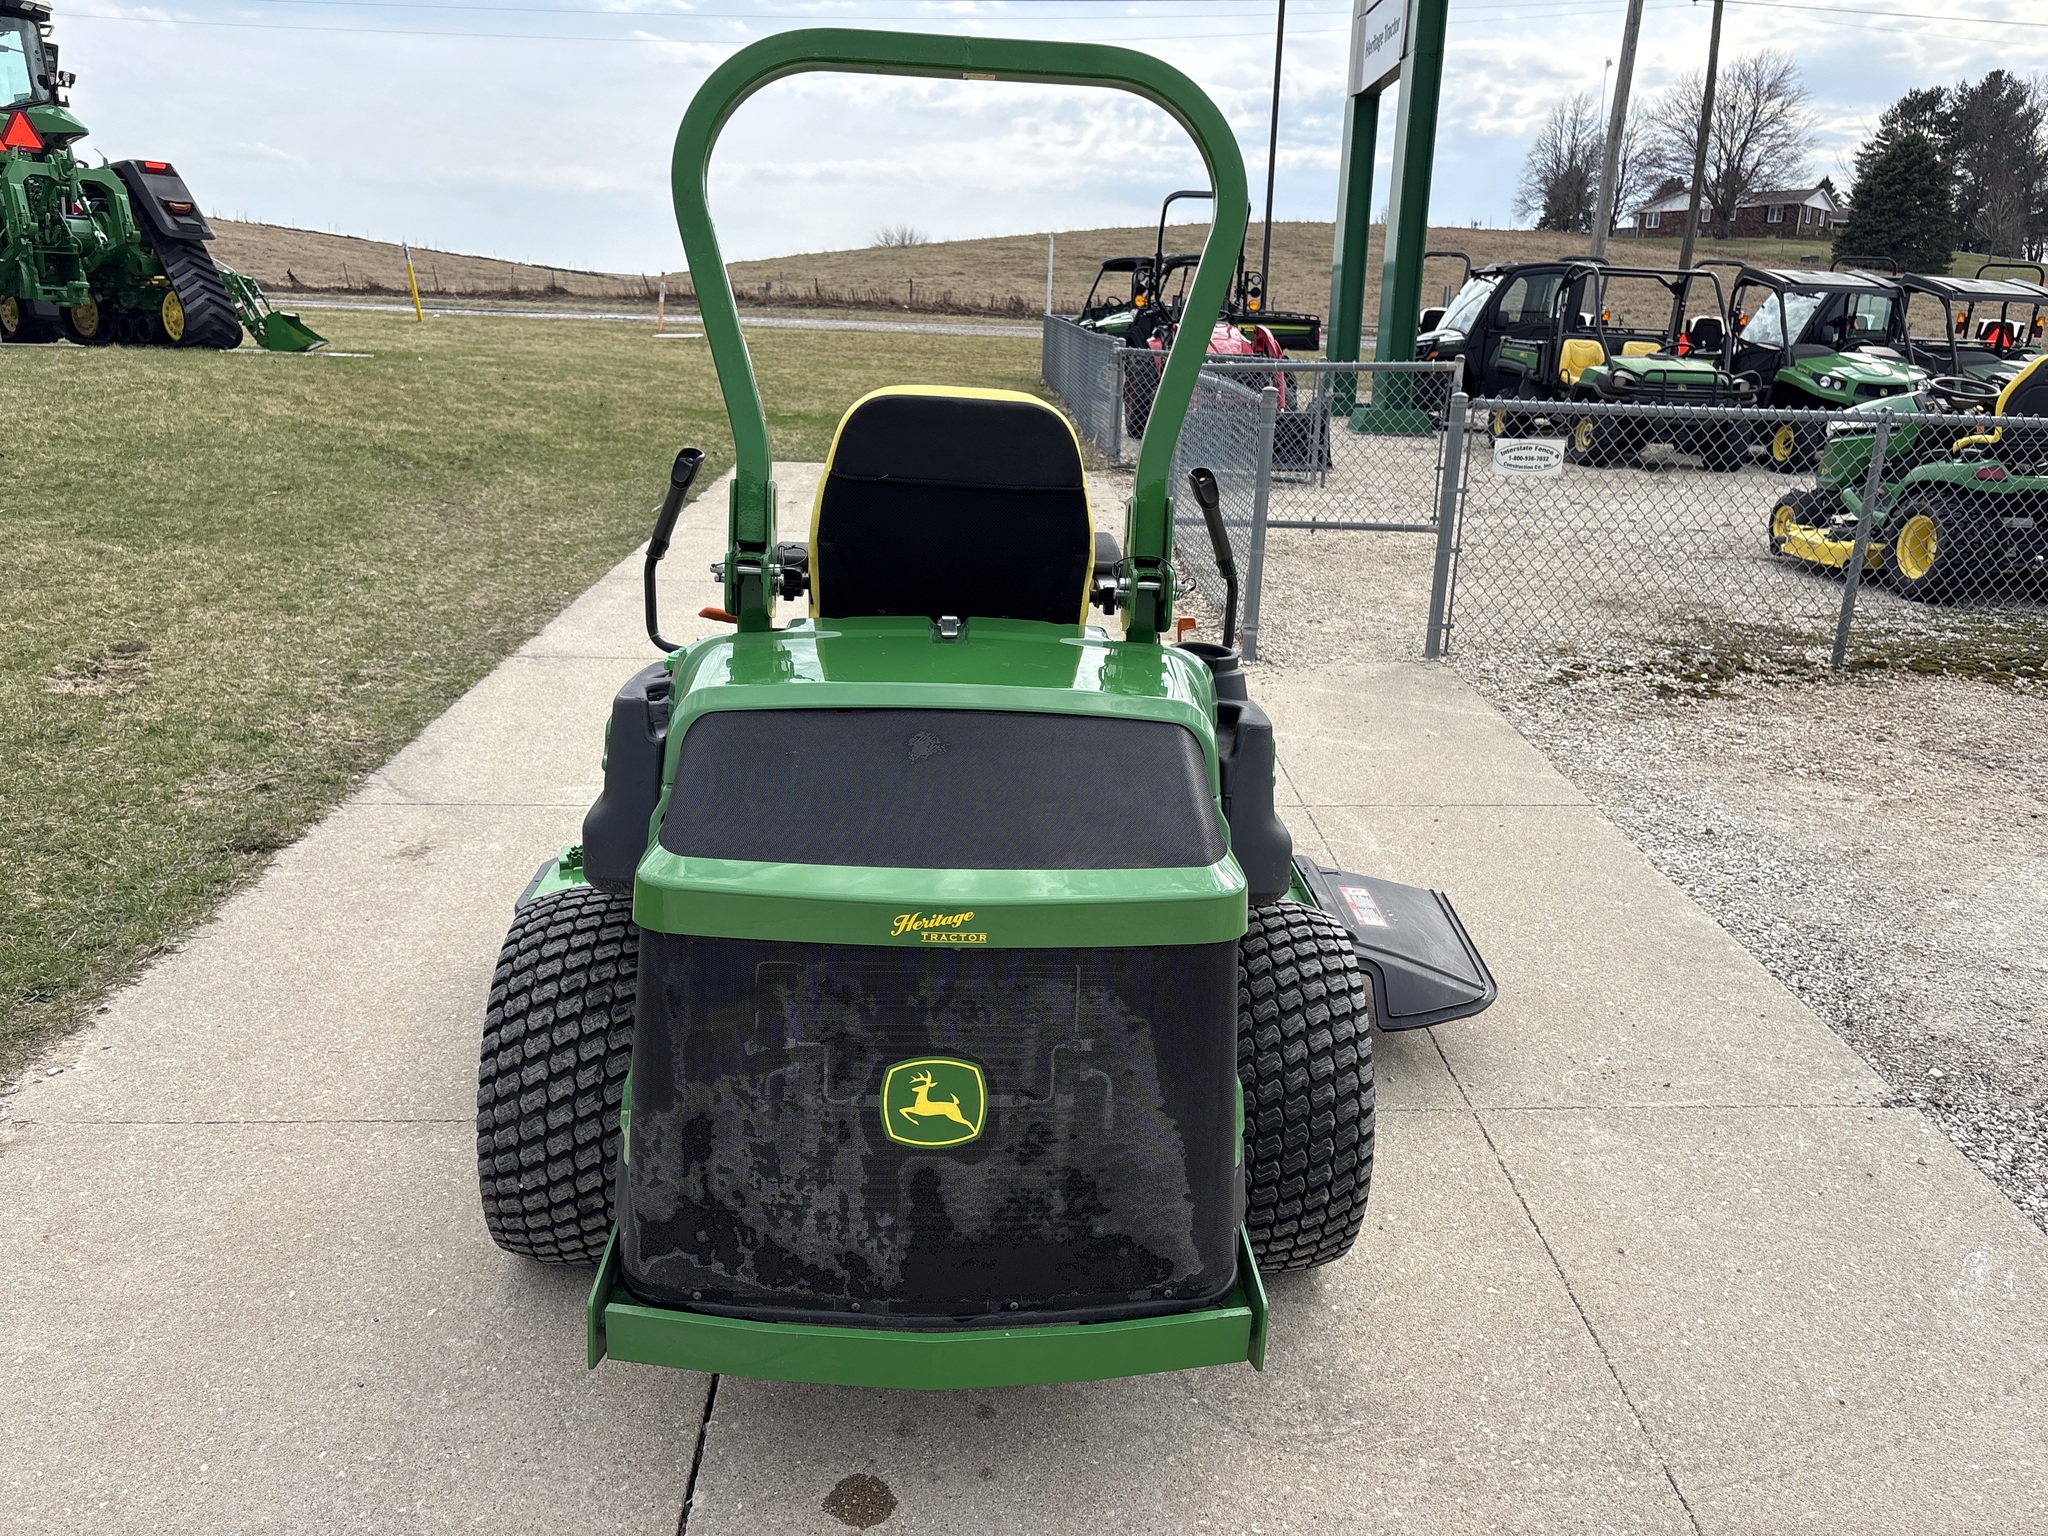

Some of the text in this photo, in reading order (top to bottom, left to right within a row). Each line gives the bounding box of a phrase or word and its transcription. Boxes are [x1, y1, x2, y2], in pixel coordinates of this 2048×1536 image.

[1500, 445, 1533, 457] Interstate
[1534, 445, 1554, 456] Fence
[1503, 461, 1534, 470] Construction
[890, 911, 976, 937] Heritage
[921, 933, 987, 942] TRACTOR
